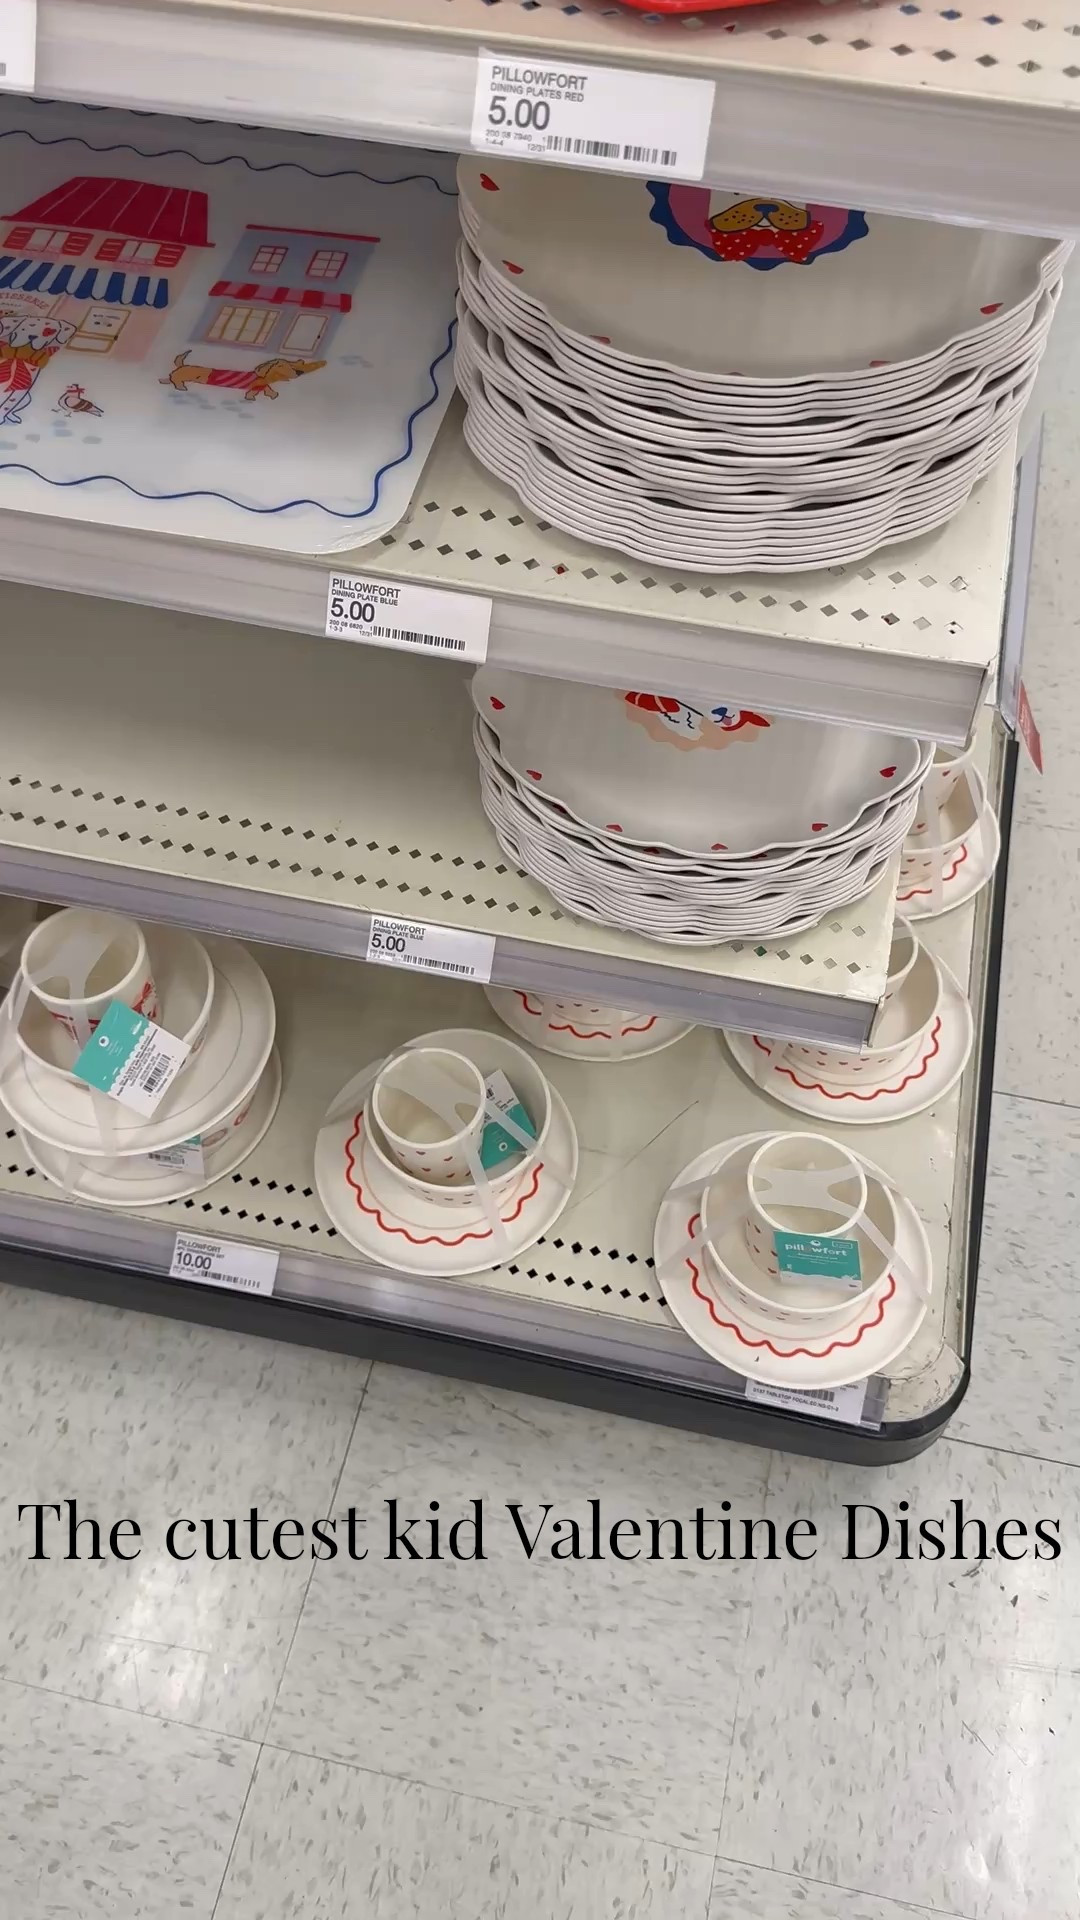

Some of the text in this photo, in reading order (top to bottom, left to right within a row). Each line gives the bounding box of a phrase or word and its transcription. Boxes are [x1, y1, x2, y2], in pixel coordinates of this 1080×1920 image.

[492, 65, 588, 90] PILLOWFORT
[490, 82, 584, 102] DINING PLATES RED
[488, 95, 550, 131] 5.00
[331, 589, 399, 606] DINING PLATE BLUE
[332, 578, 401, 599] PILLOWFORT
[330, 597, 375, 623] 5.00
[372, 926, 424, 941] DINING PLATE BLUE
[373, 919, 426, 935] PILLOWFORT
[371, 933, 406, 953] 5.00
[178, 1238, 221, 1253] PILLOWFORT
[177, 1251, 212, 1270] 10.00
[766, 1390, 792, 1400] TABLETOP
